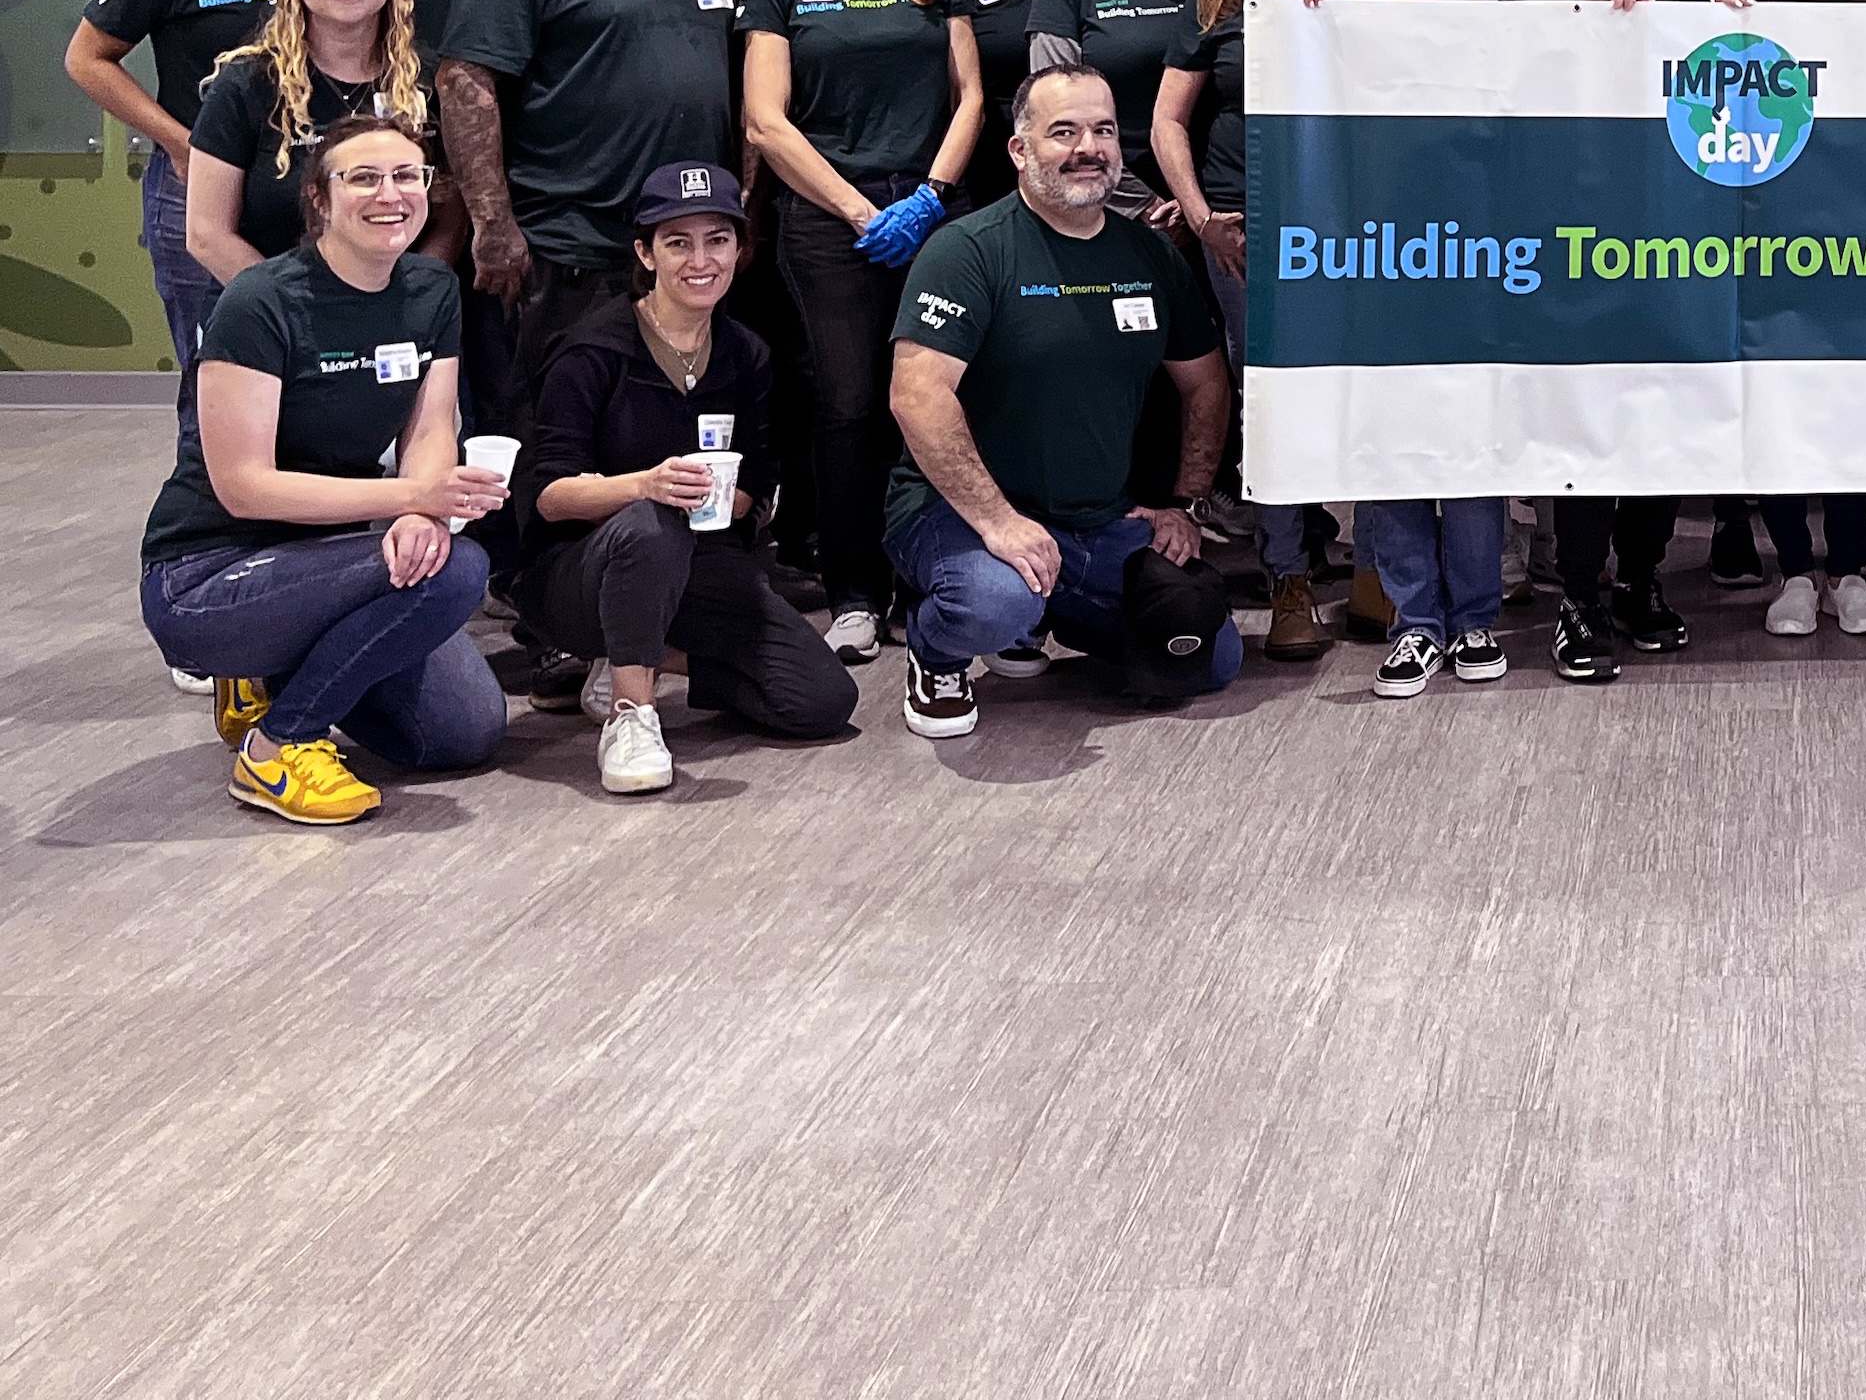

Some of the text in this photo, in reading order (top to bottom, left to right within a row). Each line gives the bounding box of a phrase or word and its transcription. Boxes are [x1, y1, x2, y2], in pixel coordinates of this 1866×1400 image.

[797, 1, 845, 16] Building
[1097, 5, 1179, 20] Building Tomorrow
[1662, 59, 1828, 103] IMPACT
[1697, 120, 1780, 174] day
[1278, 220, 1543, 296] Building
[1020, 281, 1153, 297] Building Tomorrow Together
[917, 291, 966, 318] IMPACT
[920, 309, 947, 330] day
